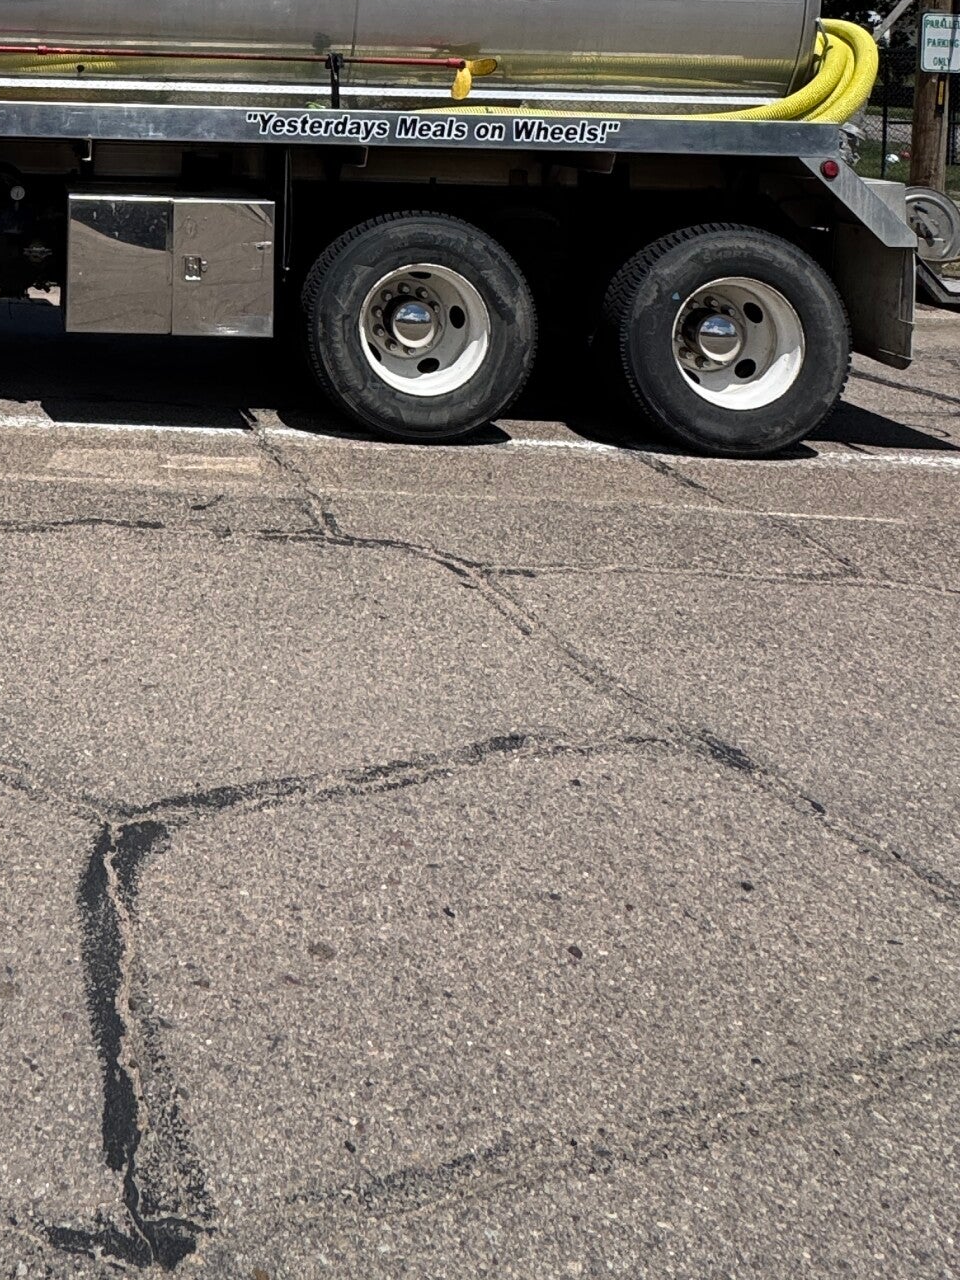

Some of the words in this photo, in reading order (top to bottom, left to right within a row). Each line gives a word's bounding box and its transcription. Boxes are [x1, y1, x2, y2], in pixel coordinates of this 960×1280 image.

[247, 112, 388, 142] "Yesterdays
[396, 116, 468, 140] Meals
[474, 122, 505, 141] on
[512, 119, 620, 144] Wheels!"
